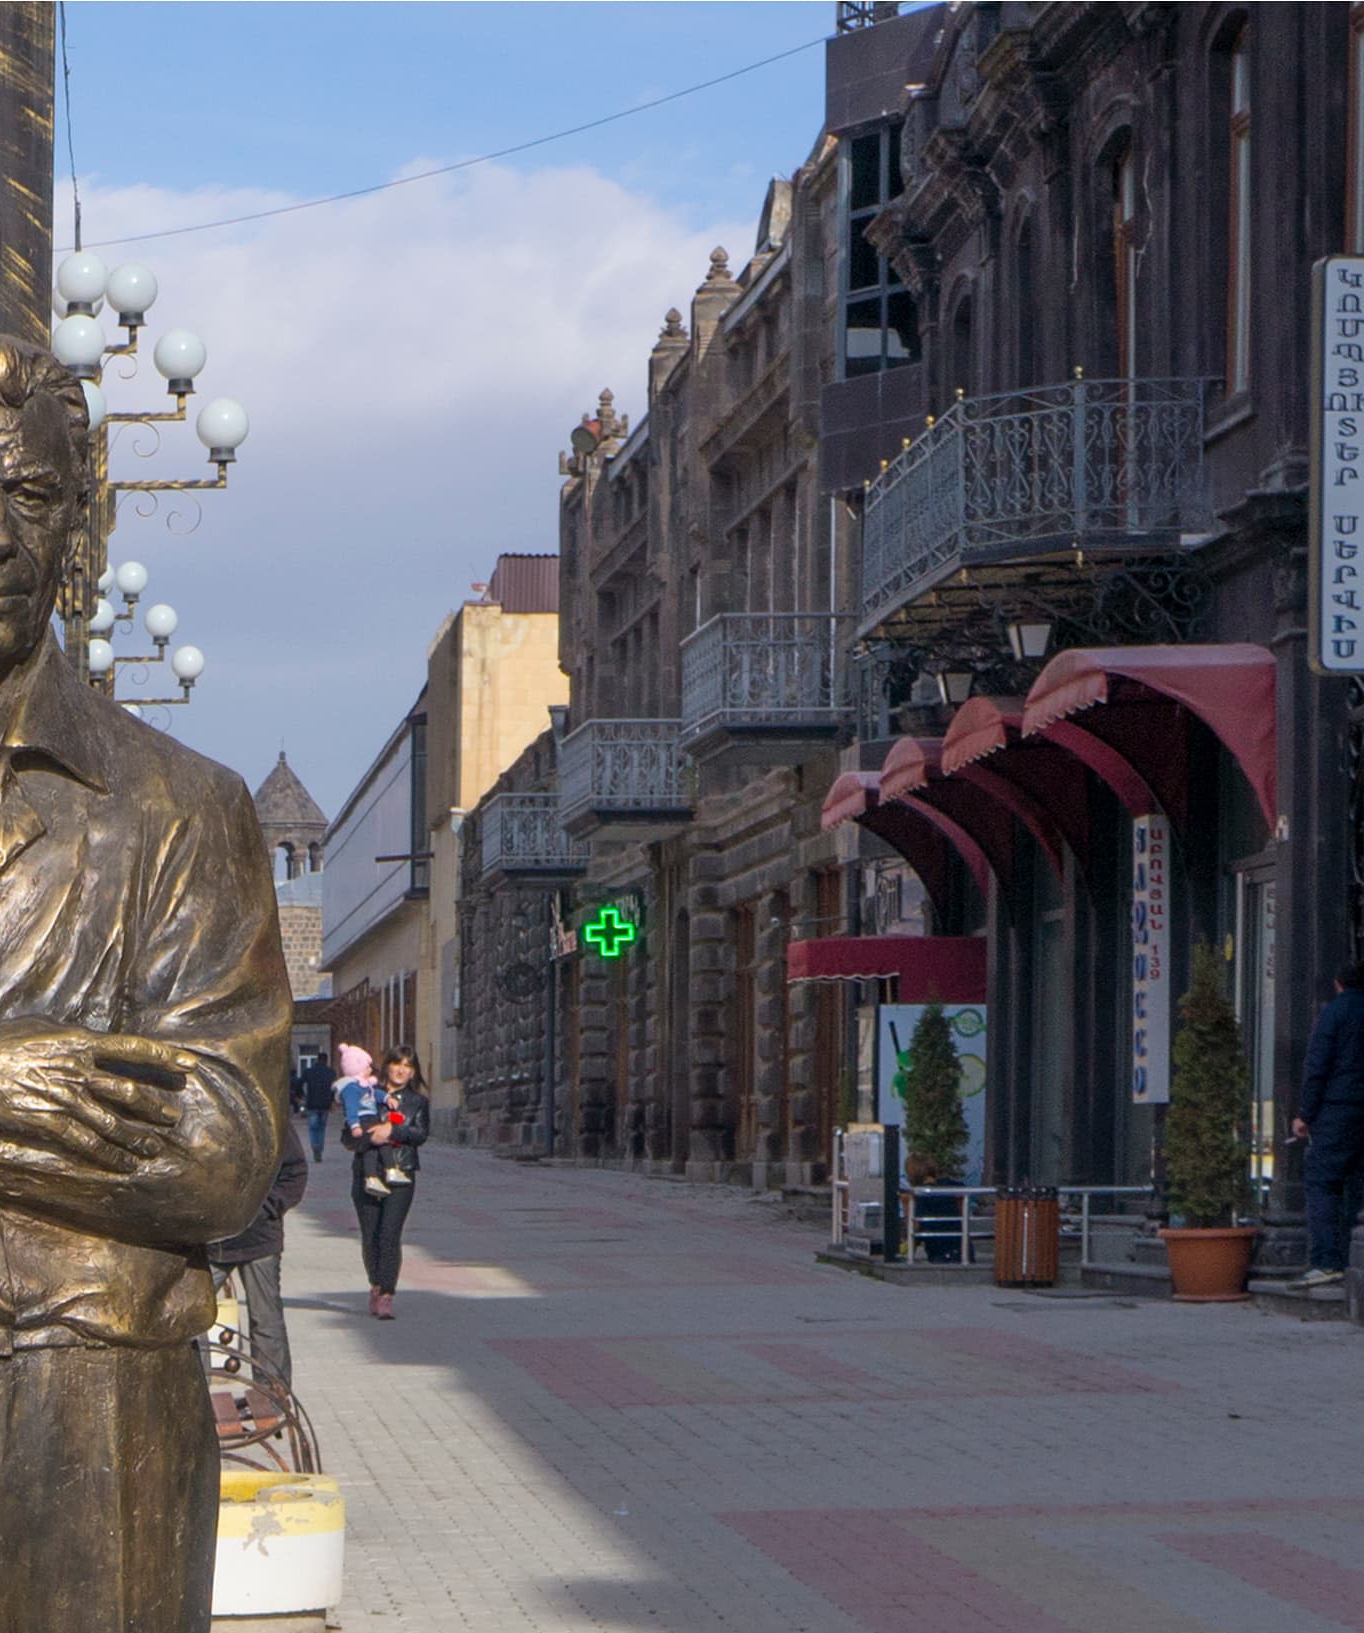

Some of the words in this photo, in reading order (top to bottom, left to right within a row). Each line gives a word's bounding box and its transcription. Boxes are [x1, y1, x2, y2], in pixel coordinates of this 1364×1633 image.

[1332, 516, 1361, 658] ՍԵՐՎԻՍ
[1149, 829, 1164, 931] ԱԲՈՎՅԱՆ
[1149, 943, 1161, 981] 139
